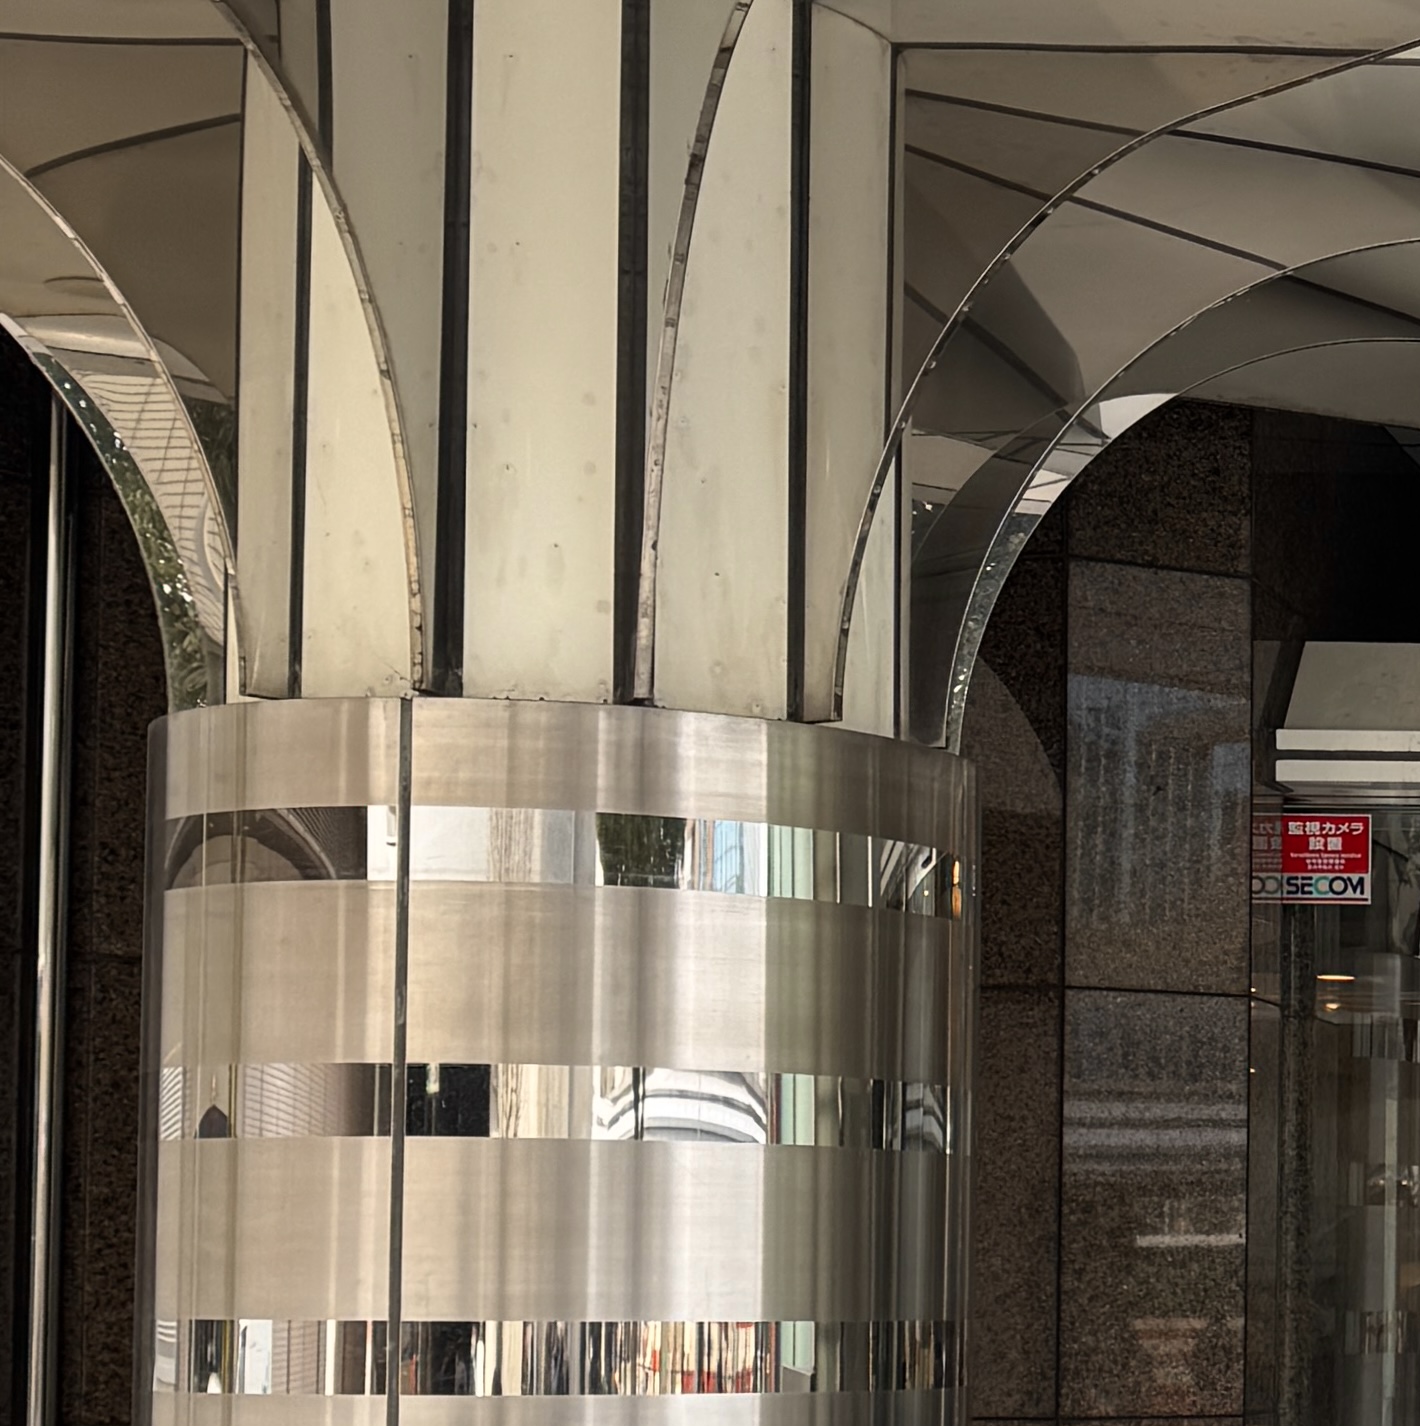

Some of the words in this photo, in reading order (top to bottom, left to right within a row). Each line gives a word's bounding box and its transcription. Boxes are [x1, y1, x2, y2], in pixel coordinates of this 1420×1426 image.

[1288, 821, 1364, 835] 監視カメラ
[1286, 876, 1365, 896] SECOM
